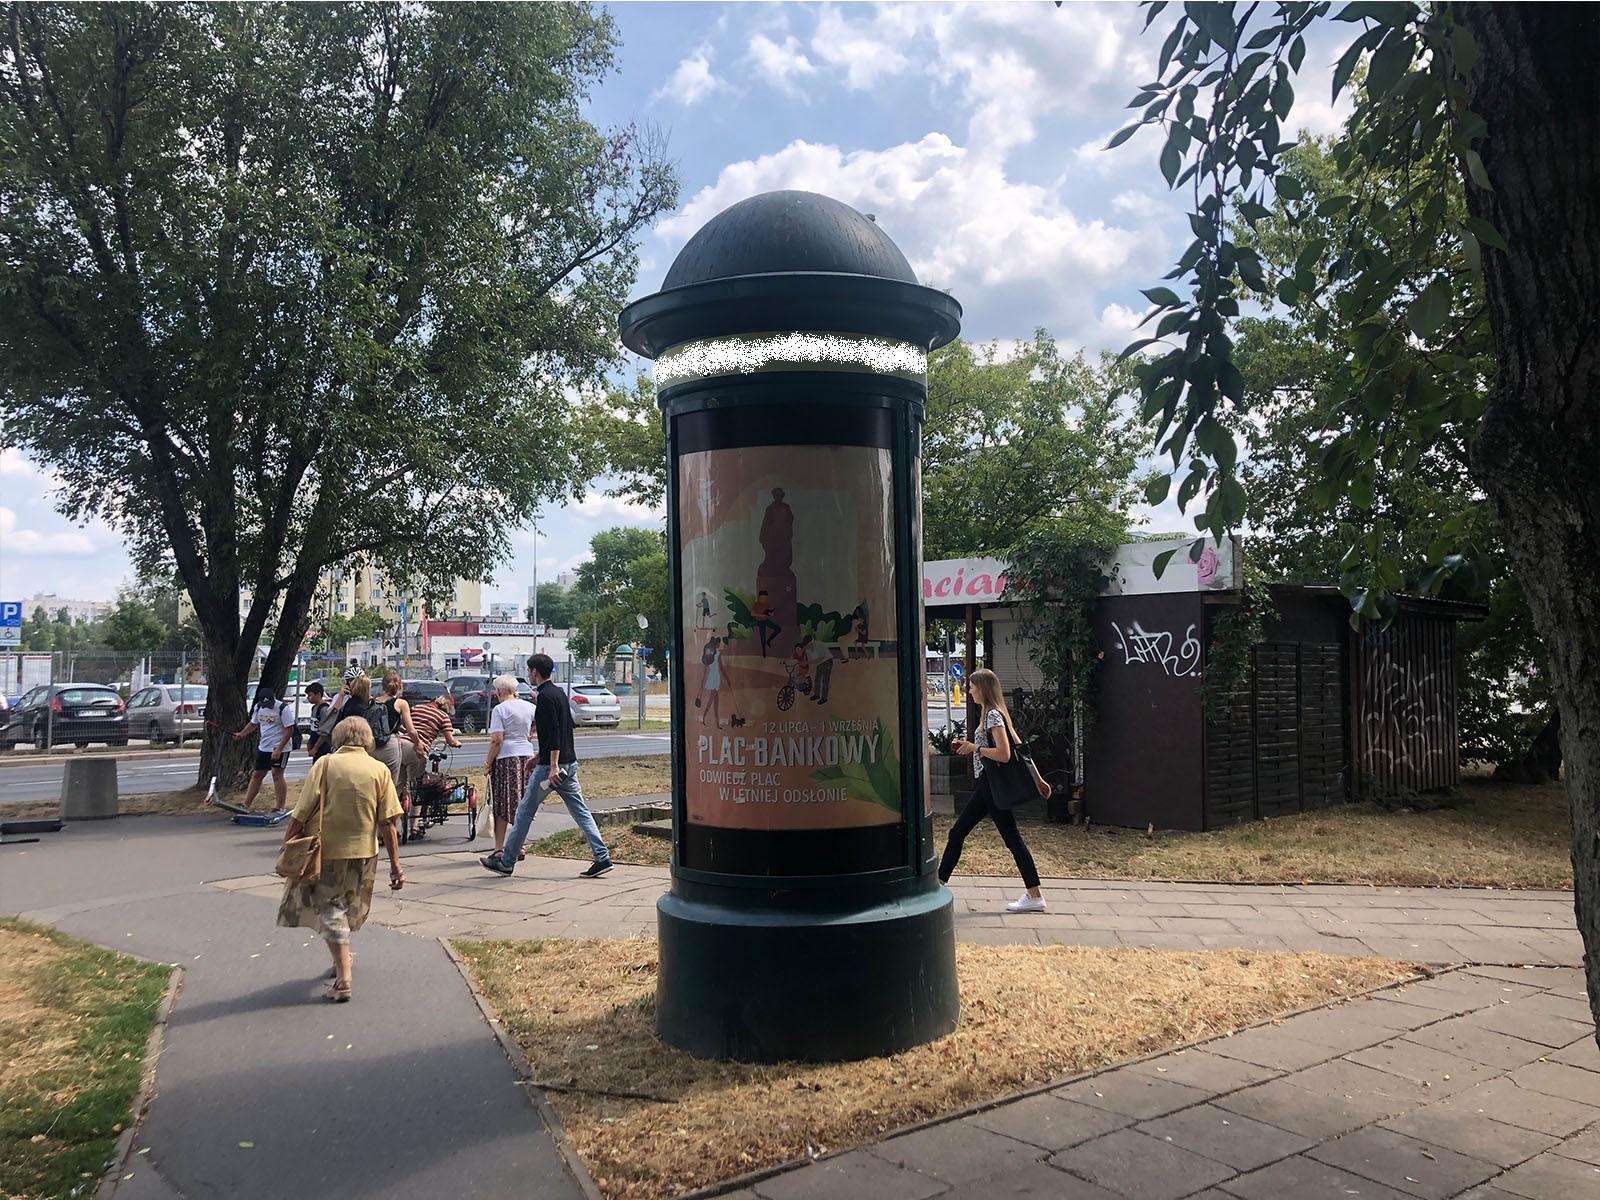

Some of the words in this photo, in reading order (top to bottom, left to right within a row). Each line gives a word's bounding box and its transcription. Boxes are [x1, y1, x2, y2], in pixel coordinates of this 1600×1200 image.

[4, 604, 18, 620] P
[763, 722, 776, 734] 12
[779, 721, 809, 733] LIPCA
[820, 720, 826, 732] 1
[829, 718, 880, 732] WRZEŚNIA
[697, 734, 746, 766] PLAC
[755, 734, 880, 767] BANKOWY
[699, 769, 747, 786] ODWIEDŹ
[751, 772, 781, 786] PLAC
[719, 787, 731, 801] W
[733, 788, 778, 803] LETNIEJ
[783, 787, 848, 803] ODSŁONIE
